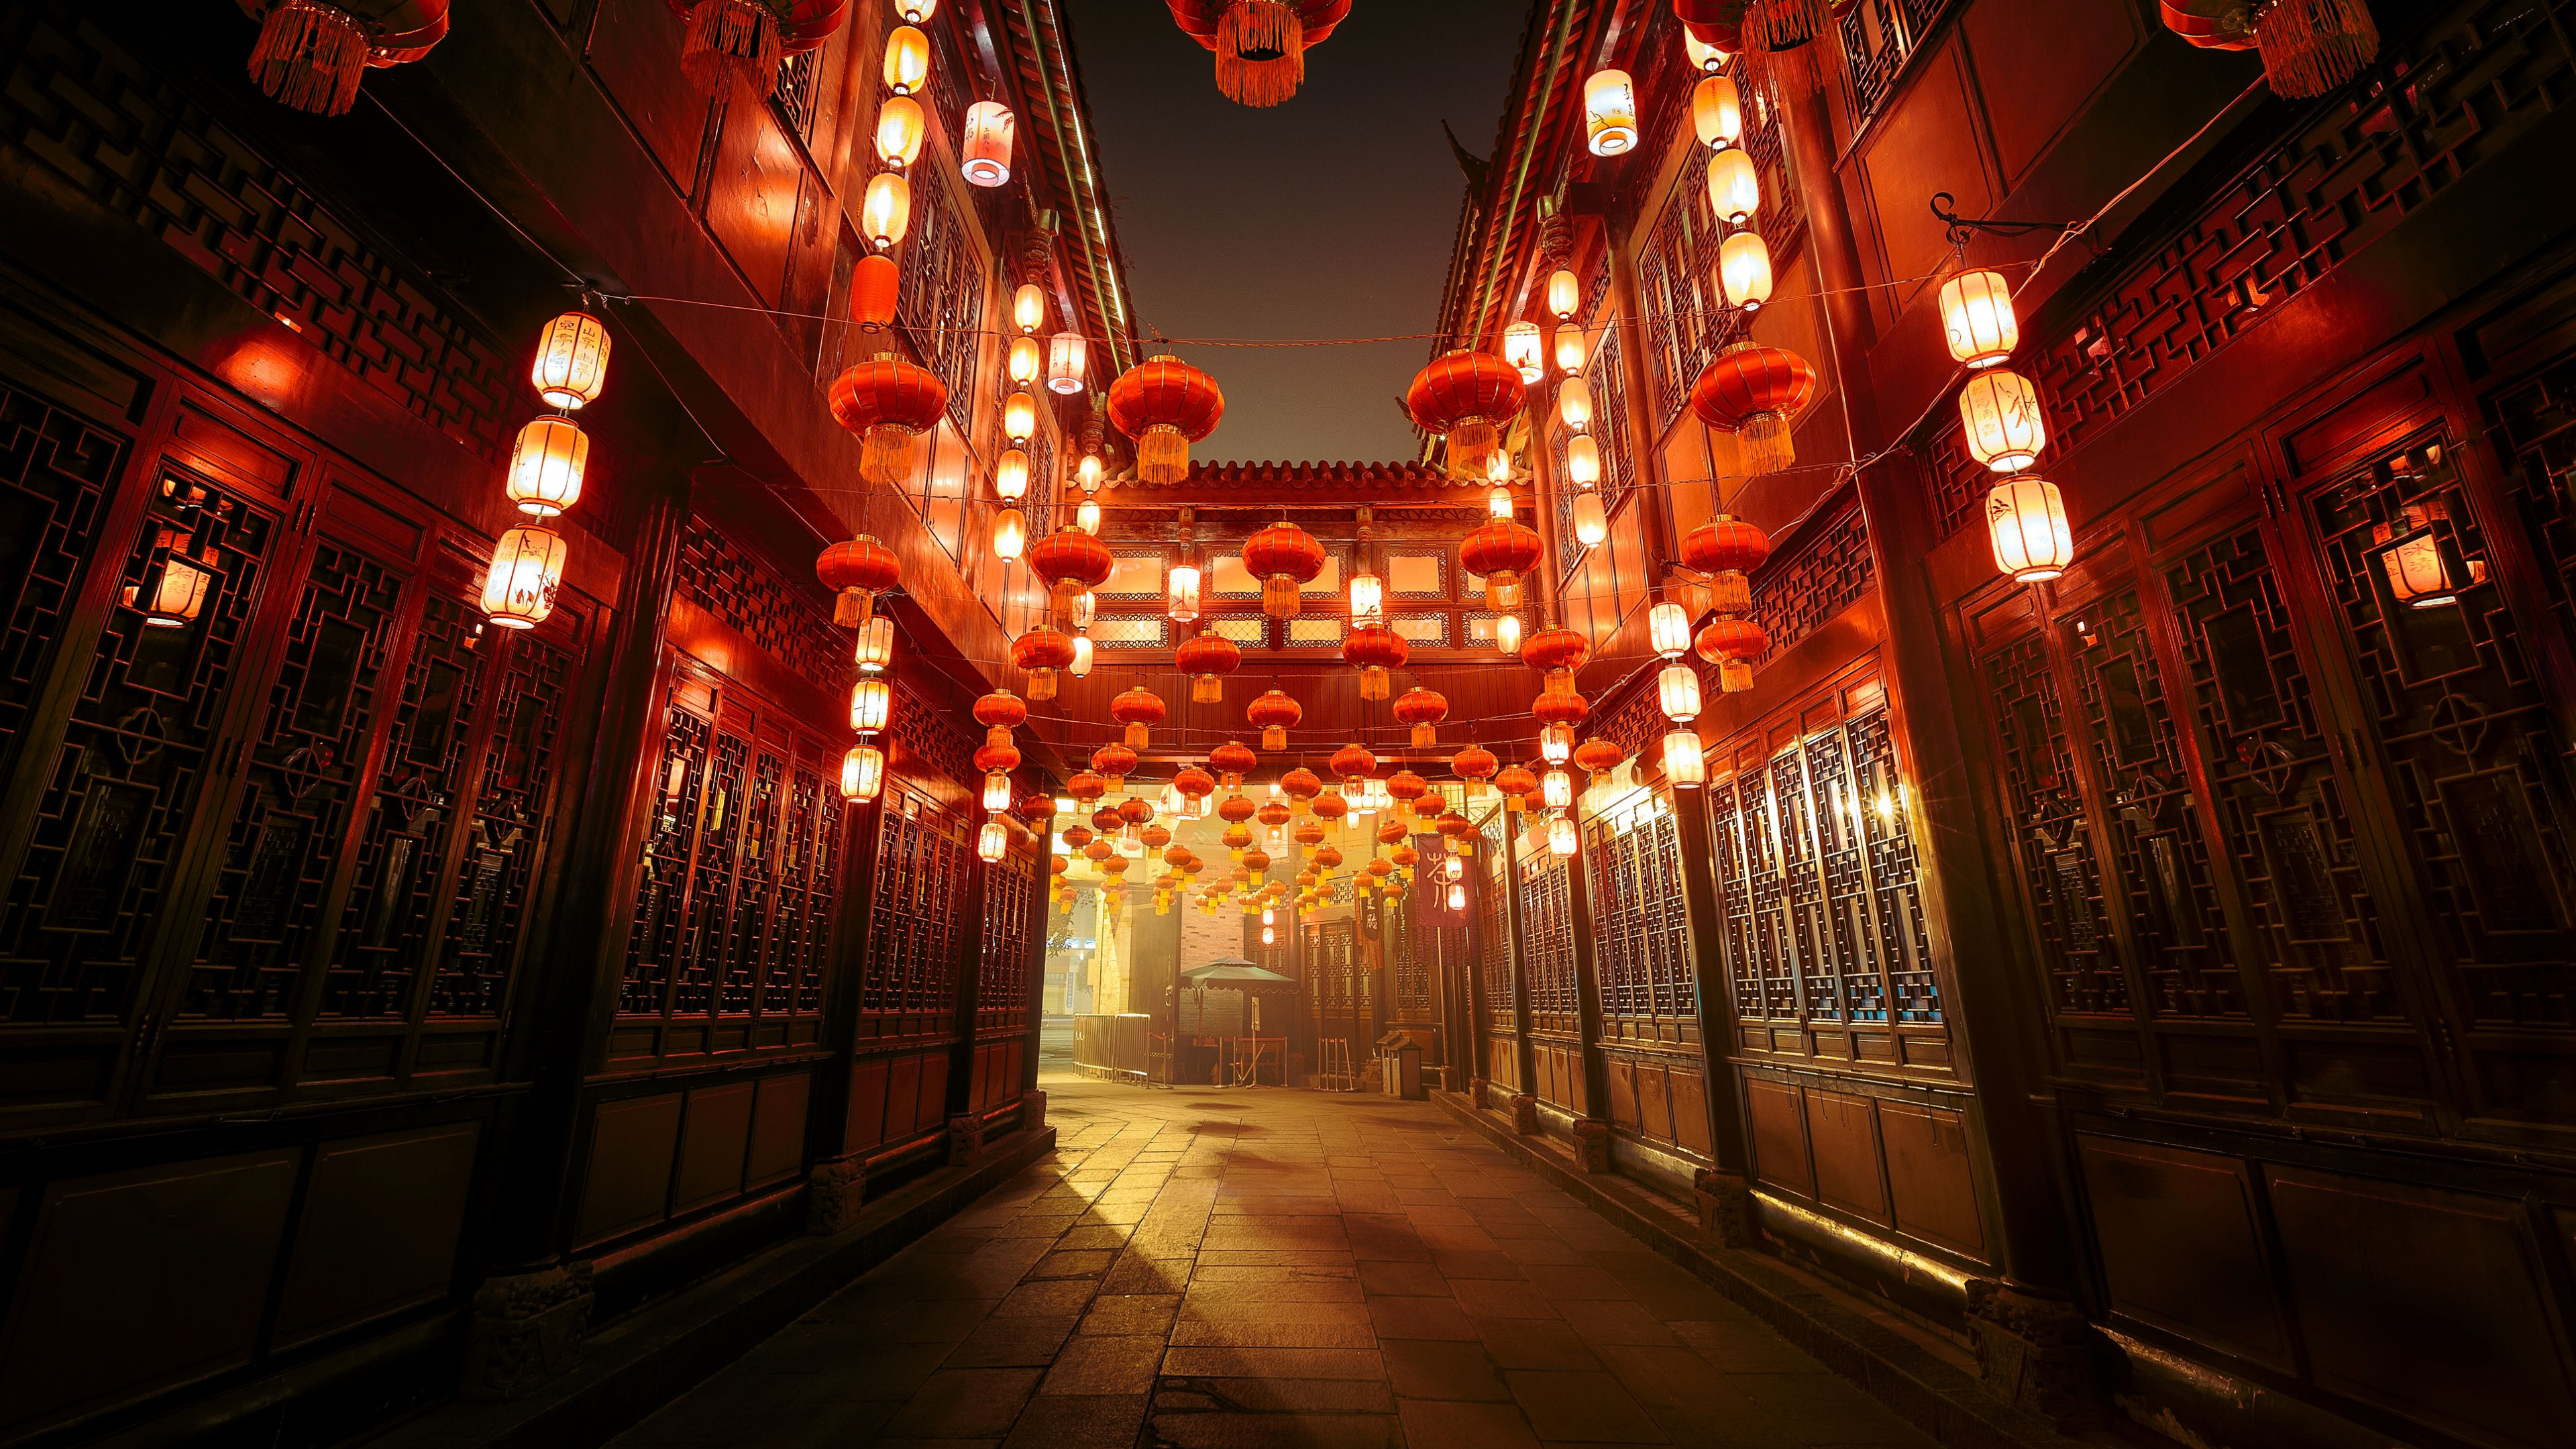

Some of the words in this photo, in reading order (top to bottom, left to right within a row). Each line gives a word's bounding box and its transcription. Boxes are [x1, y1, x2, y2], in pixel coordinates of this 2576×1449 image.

[547, 320, 575, 369] 空亭夕照
[574, 327, 596, 380] 山亭幽翠
